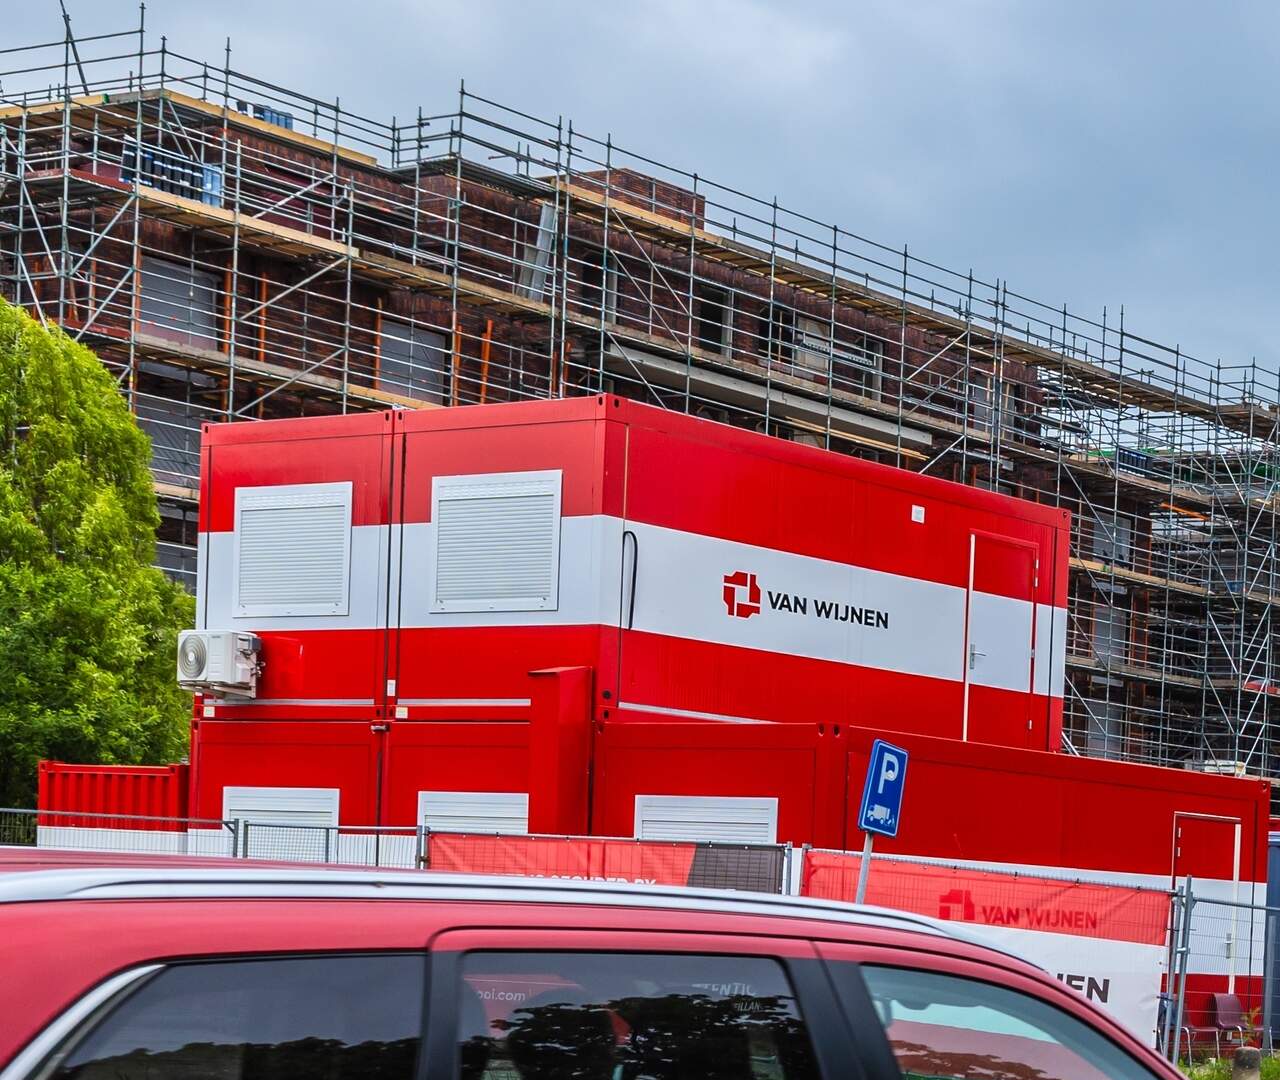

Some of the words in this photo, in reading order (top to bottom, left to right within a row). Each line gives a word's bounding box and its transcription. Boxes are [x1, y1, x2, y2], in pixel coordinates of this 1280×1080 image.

[767, 590, 807, 615] VAN
[813, 599, 889, 630] WIJNEN
[877, 752, 899, 794] P
[981, 904, 1020, 925] VAN
[1026, 908, 1098, 930] WIJNEN
